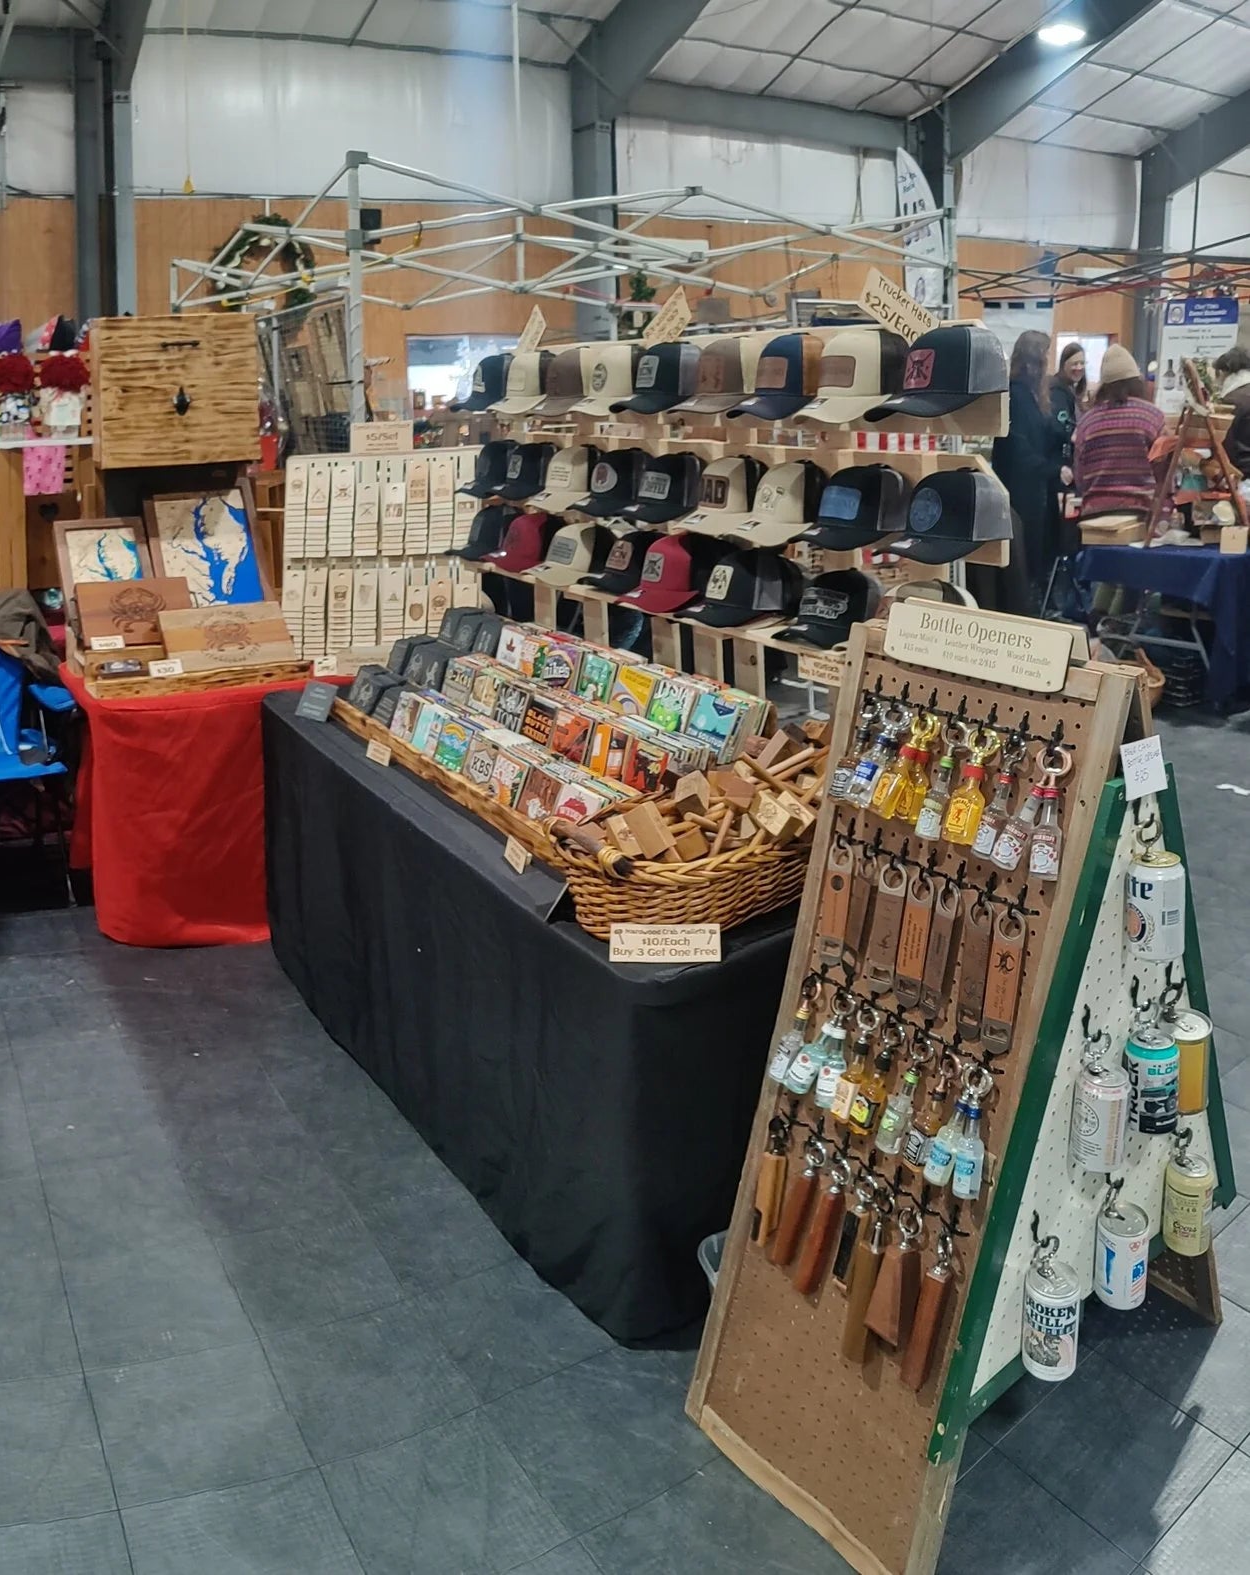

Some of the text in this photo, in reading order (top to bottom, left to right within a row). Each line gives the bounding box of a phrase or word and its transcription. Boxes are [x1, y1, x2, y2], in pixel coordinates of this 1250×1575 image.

[877, 275, 933, 328] Trucker Hats
[862, 291, 924, 343] $25/Eac
[919, 612, 1034, 650] Bottle Openers
[913, 645, 930, 655] each
[944, 638, 999, 657] Leather Wrapped
[953, 654, 970, 663] each
[1005, 649, 1052, 667] Wood Handle
[1023, 668, 1042, 679] each
[471, 756, 492, 777] KBS
[642, 937, 691, 947] $10/Each
[612, 947, 718, 959] Buy 3 Get One Free
